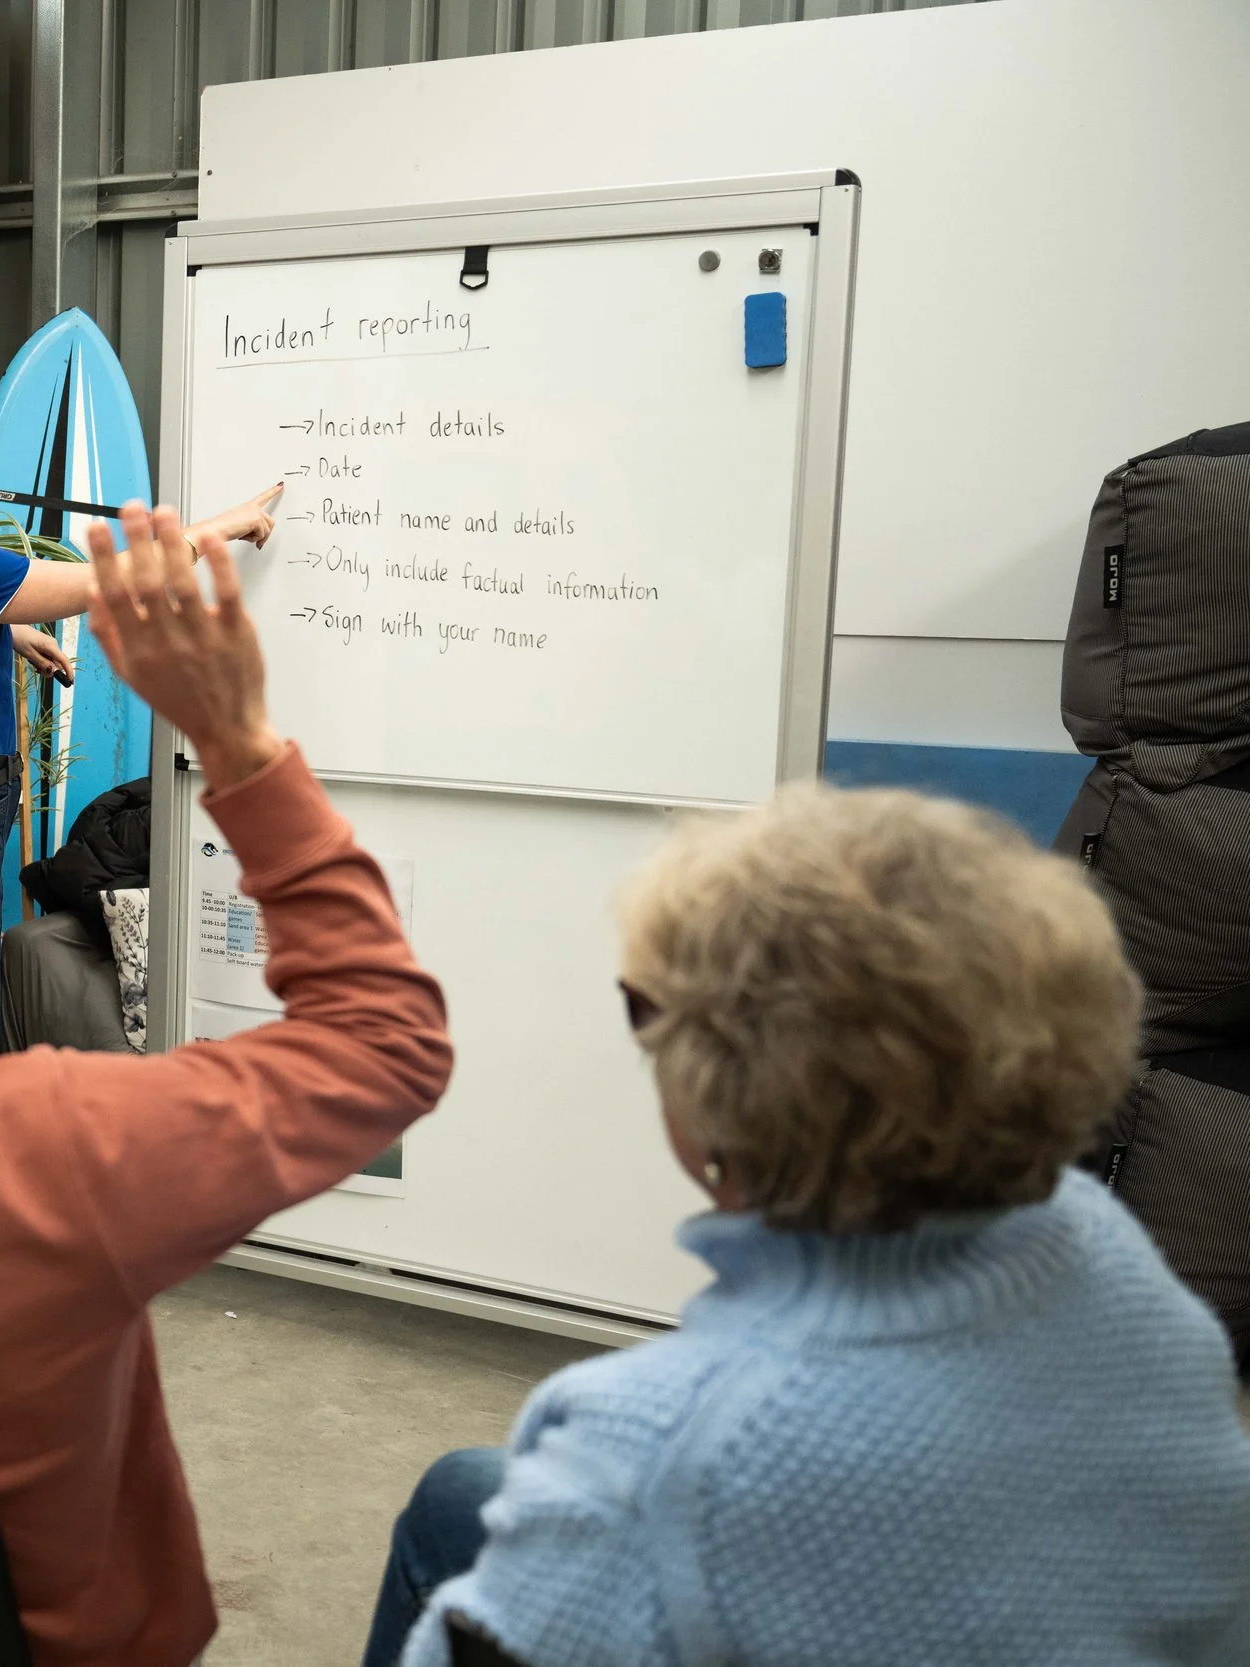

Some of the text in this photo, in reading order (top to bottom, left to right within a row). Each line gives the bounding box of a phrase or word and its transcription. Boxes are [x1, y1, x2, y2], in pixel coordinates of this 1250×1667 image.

[225, 300, 471, 358] Incident reporting
[318, 409, 505, 437] Incident details
[318, 454, 362, 478] Date
[322, 498, 575, 535] Patient name and details
[326, 545, 659, 601] Only include factual information
[1109, 554, 1118, 601] MOJO
[321, 605, 548, 654] Sign with your name
[1107, 1153, 1120, 1188] OJO
